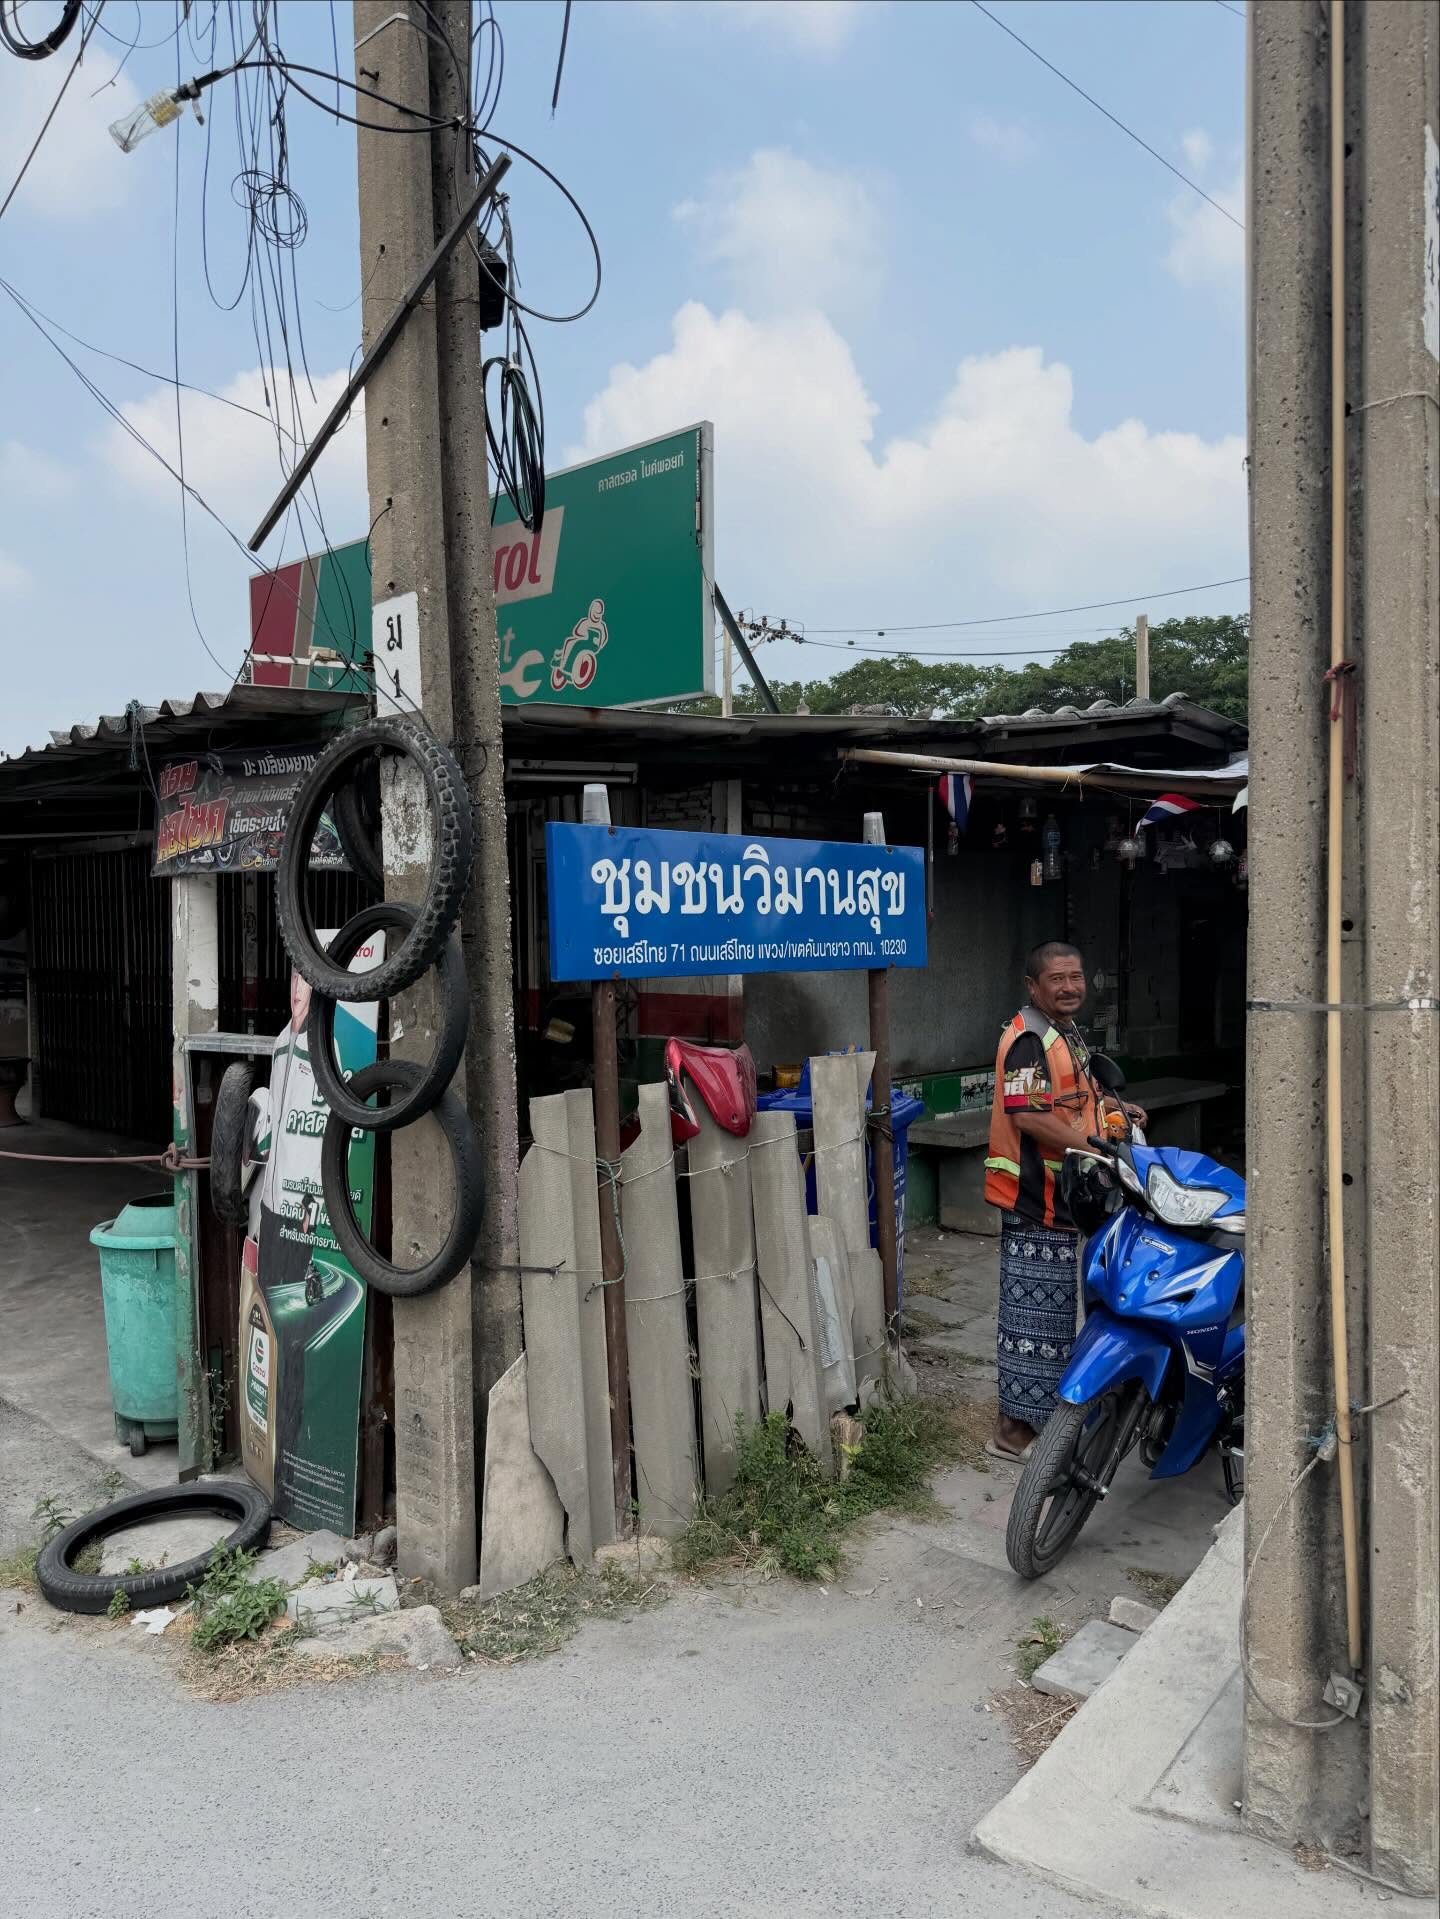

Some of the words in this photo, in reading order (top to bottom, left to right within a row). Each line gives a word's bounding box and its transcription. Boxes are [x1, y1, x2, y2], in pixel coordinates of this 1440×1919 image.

[598, 469, 638, 492] คาสตรอล
[591, 843, 905, 938] ชุมชนวิมานสุข
[593, 939, 667, 965] ซอยเสรีไทย
[671, 943, 685, 962] 71
[690, 938, 755, 962] ถนนเสรีไทย
[758, 938, 850, 959] แขวง/เขตคันนายาว
[853, 941, 876, 957] กทม.
[880, 938, 907, 956] 10230
[280, 1200, 305, 1220] อันดับ
[1186, 1325, 1219, 1335] HONDA
